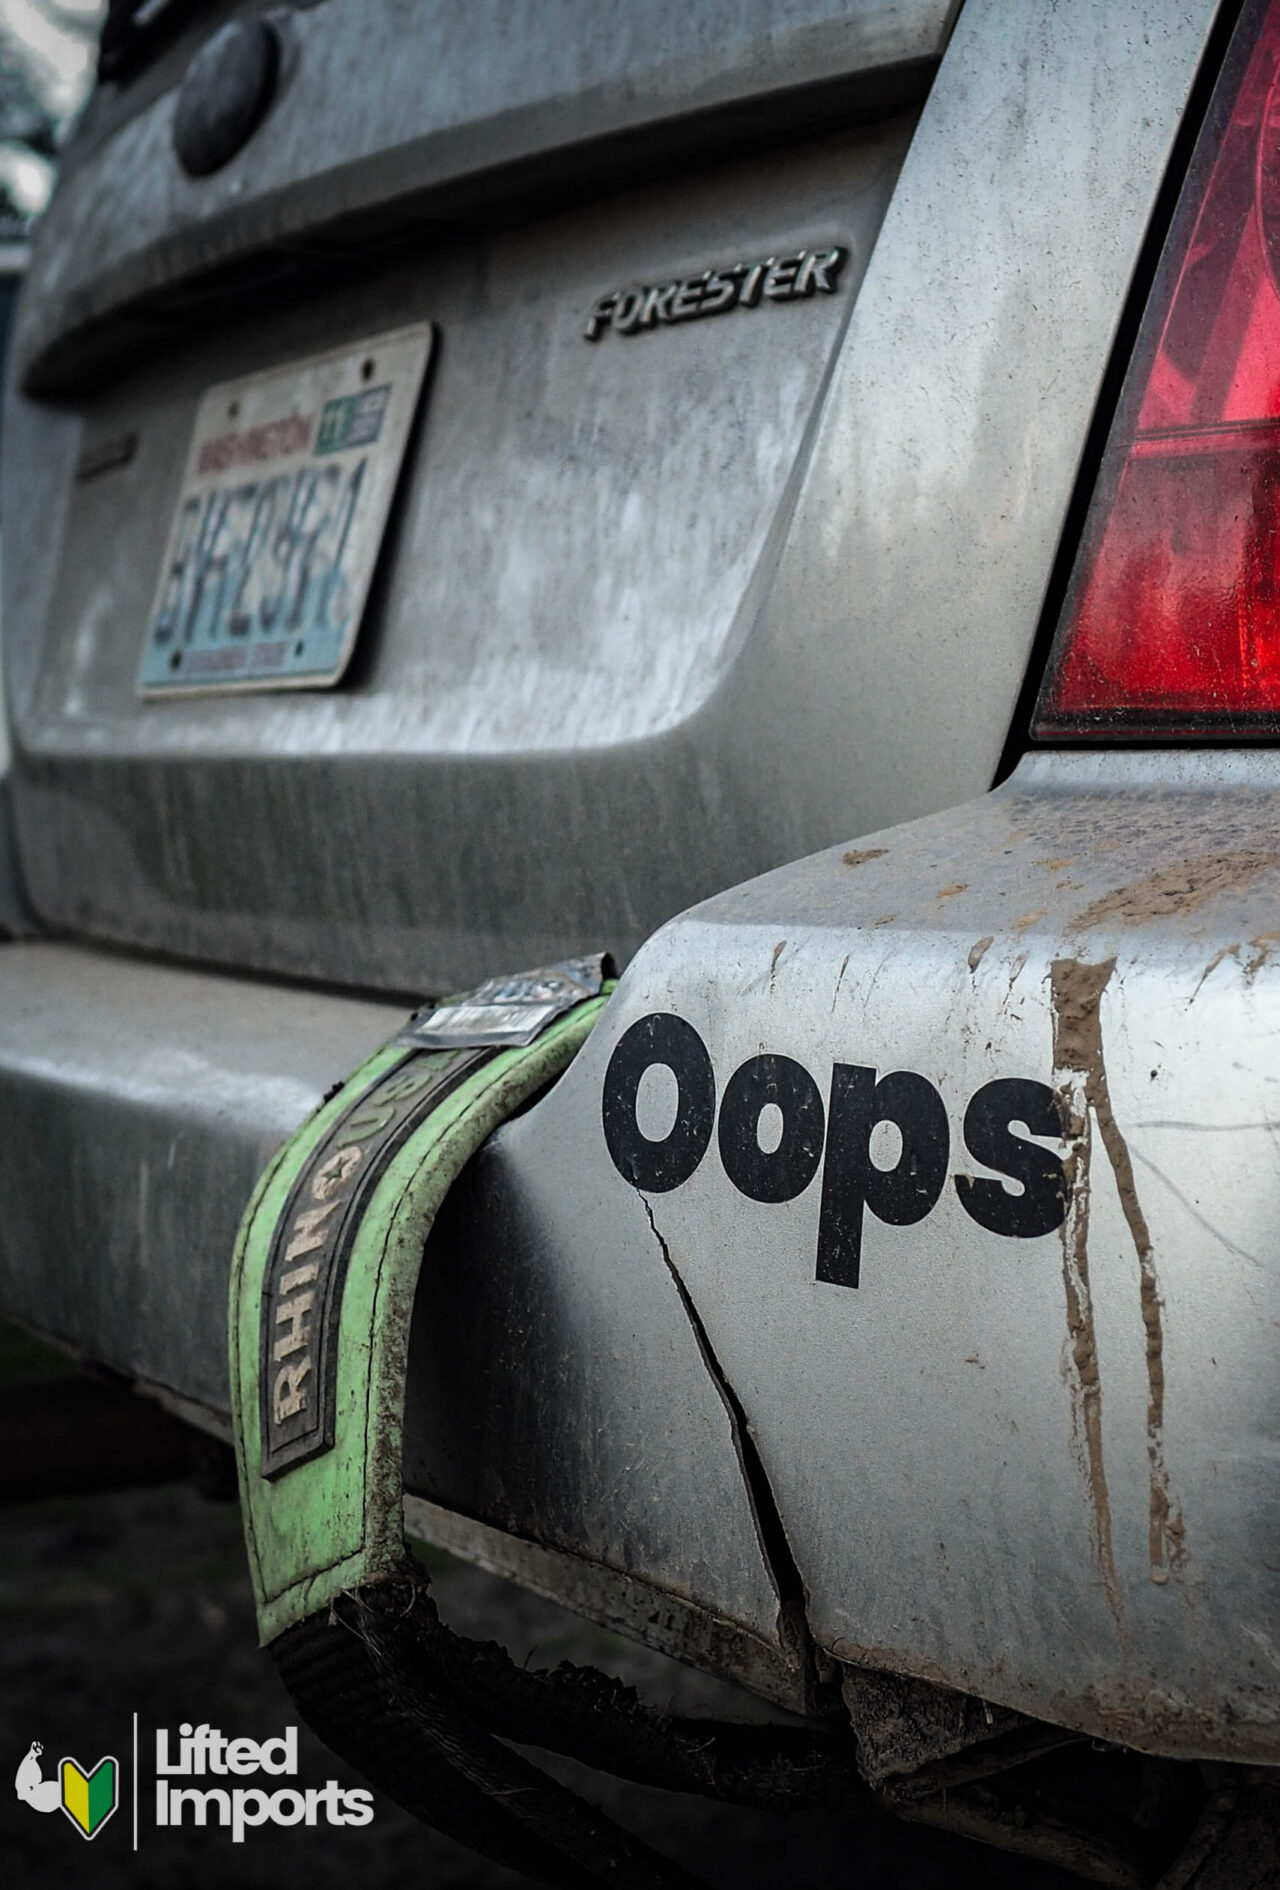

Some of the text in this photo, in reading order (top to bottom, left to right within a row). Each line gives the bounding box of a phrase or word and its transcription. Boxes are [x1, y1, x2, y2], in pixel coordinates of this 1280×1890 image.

[583, 246, 849, 341] FORESTER
[273, 1146, 363, 1425] RHINO
[602, 1012, 1072, 1289] Oops
